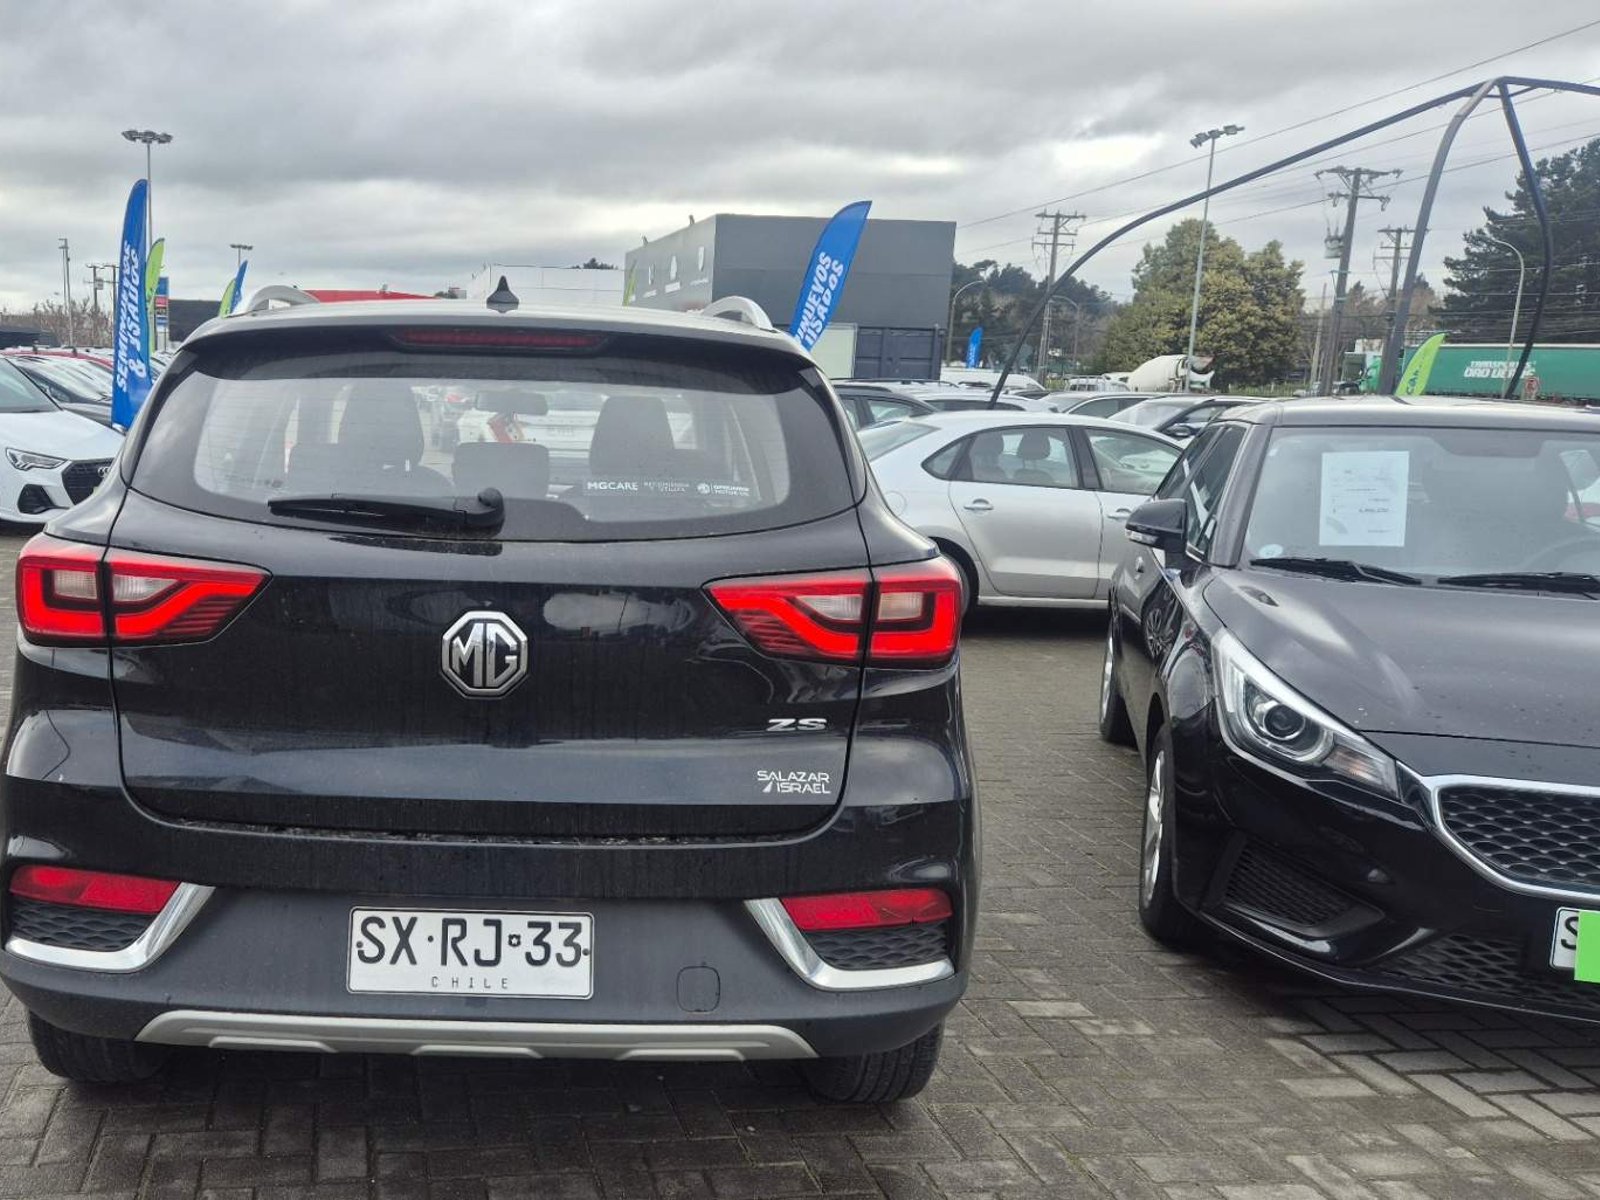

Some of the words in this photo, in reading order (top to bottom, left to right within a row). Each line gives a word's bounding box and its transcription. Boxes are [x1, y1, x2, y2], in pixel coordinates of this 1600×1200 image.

[804, 260, 843, 346] USADOS
[452, 623, 518, 687] MG
[766, 718, 827, 731] ZS
[757, 770, 830, 783] SALAZAR
[776, 782, 831, 794] ISRAEL
[431, 976, 509, 989] CHILE
